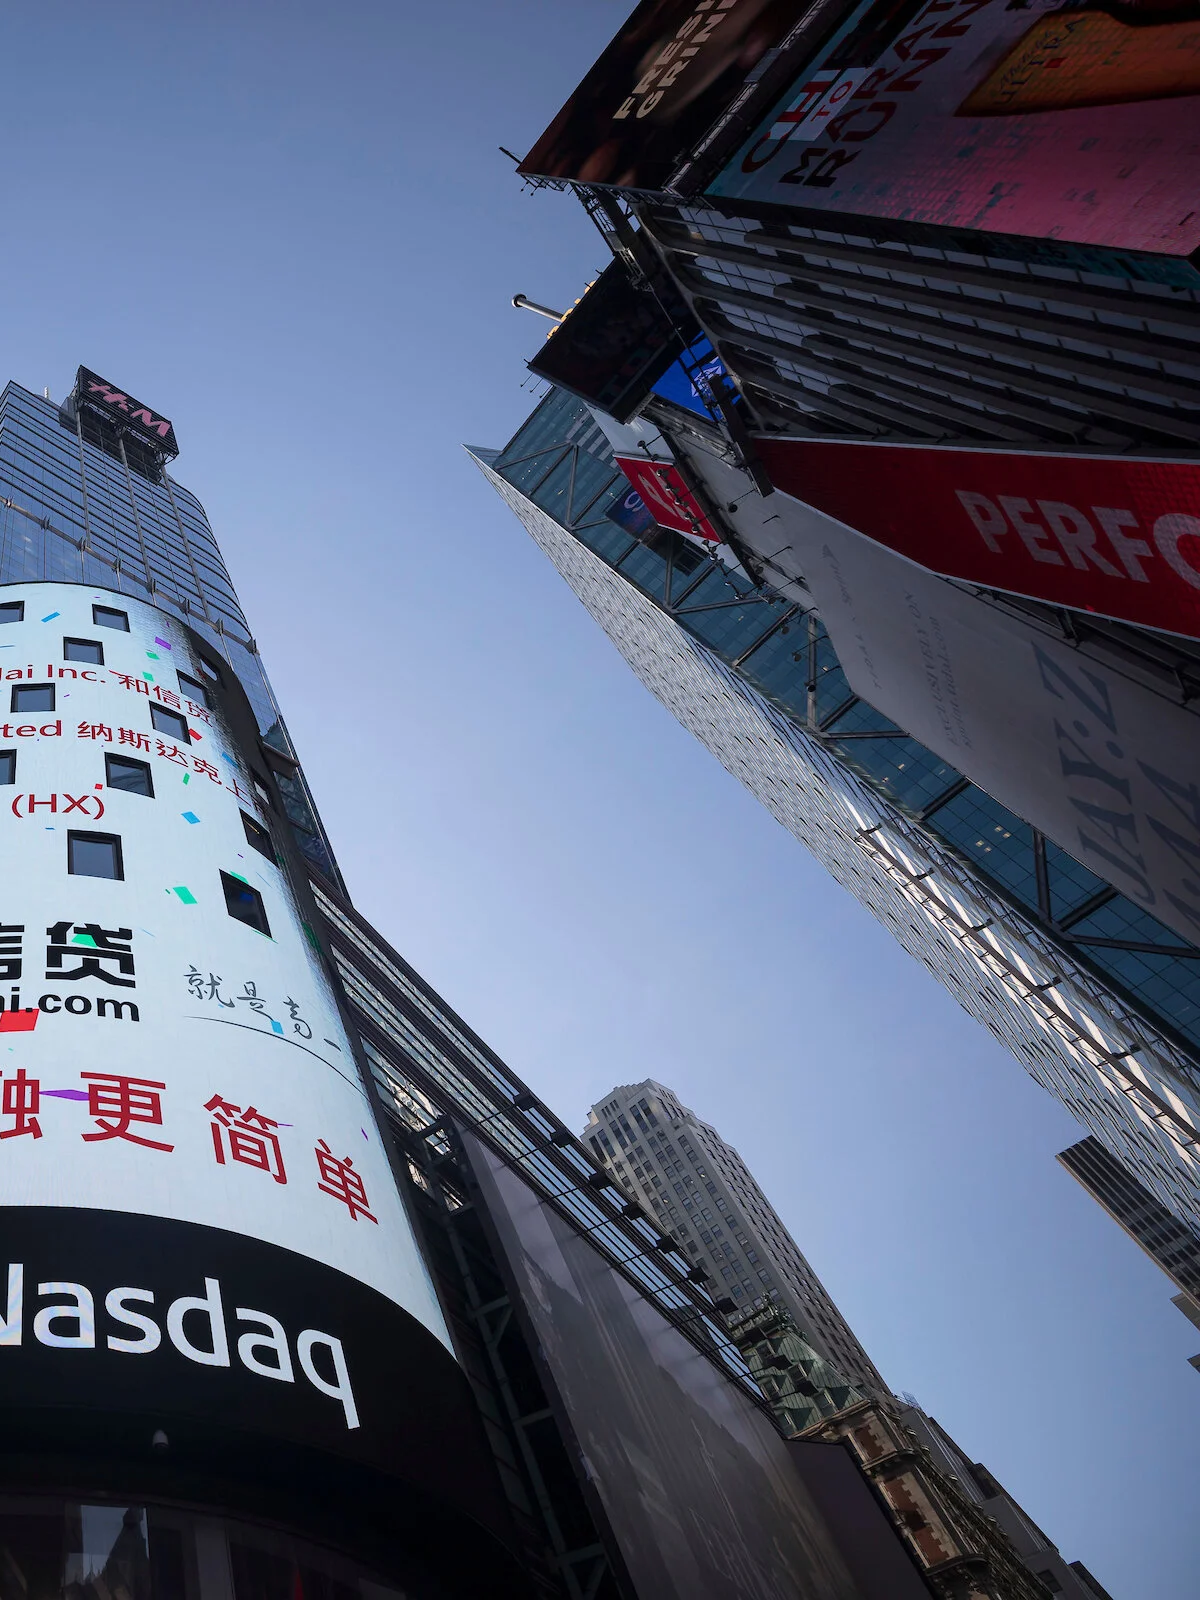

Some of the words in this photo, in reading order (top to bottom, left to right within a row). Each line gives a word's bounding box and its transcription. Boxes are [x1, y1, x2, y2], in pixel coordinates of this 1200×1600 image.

[636, 0, 738, 119] GRIN
[811, 80, 853, 122] TO
[47, 663, 107, 685] Inc.
[11, 792, 105, 820] (HX)
